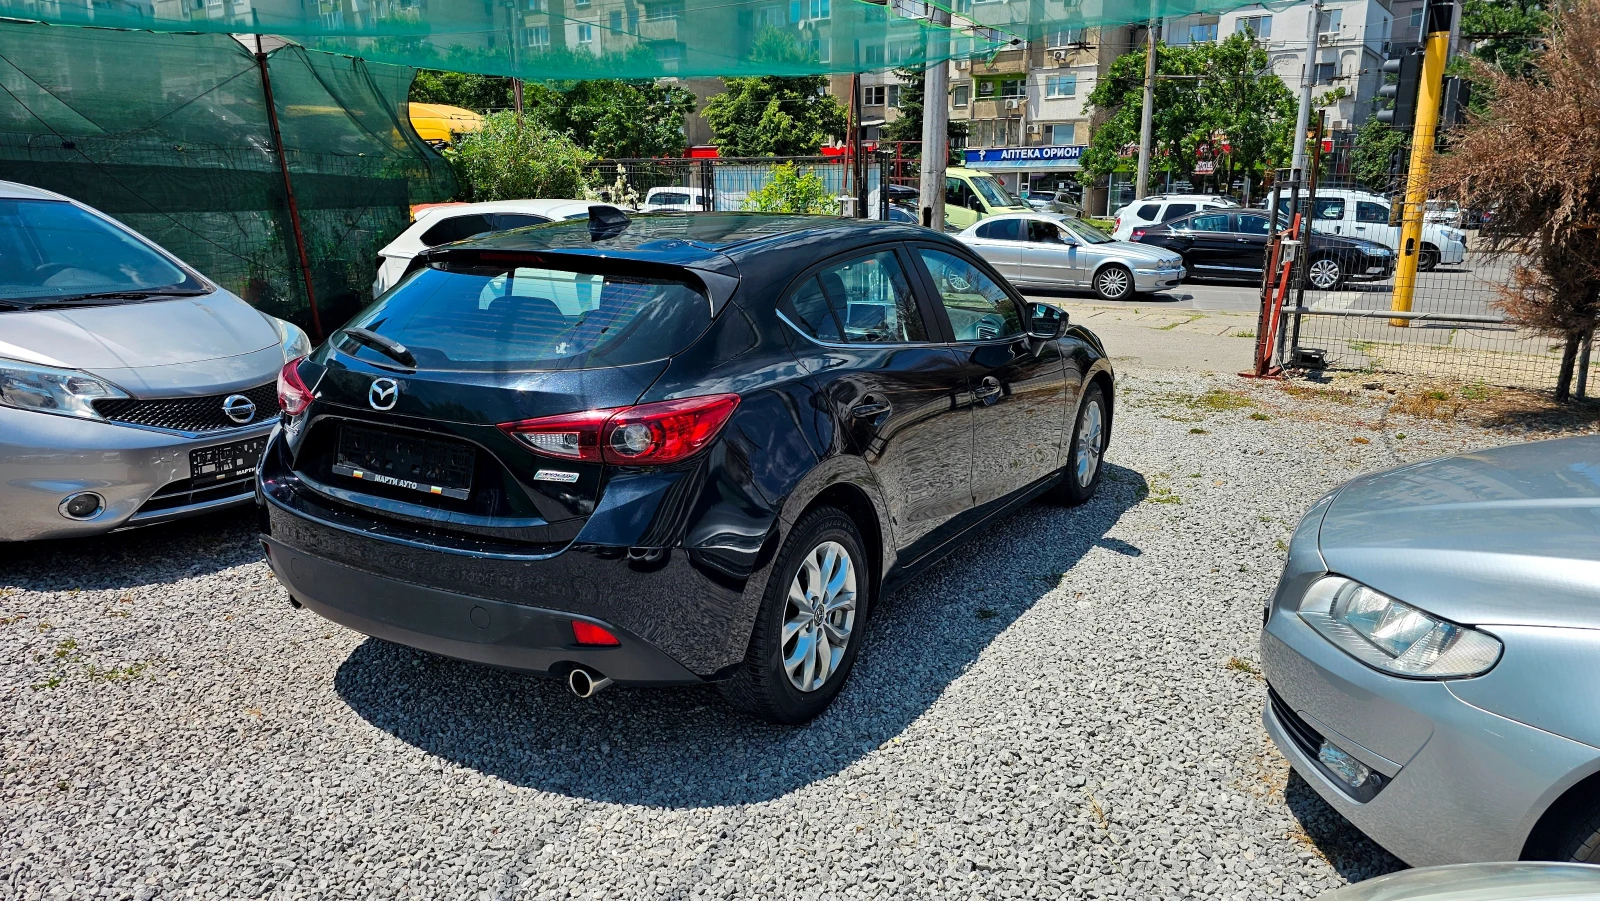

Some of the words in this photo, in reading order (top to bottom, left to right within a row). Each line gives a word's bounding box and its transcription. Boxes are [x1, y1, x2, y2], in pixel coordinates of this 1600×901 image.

[1001, 148, 1040, 159] АПТЕКА
[1042, 147, 1079, 158] ОРИОН
[374, 474, 398, 486] МАРТИ
[399, 479, 417, 489] АУТО
